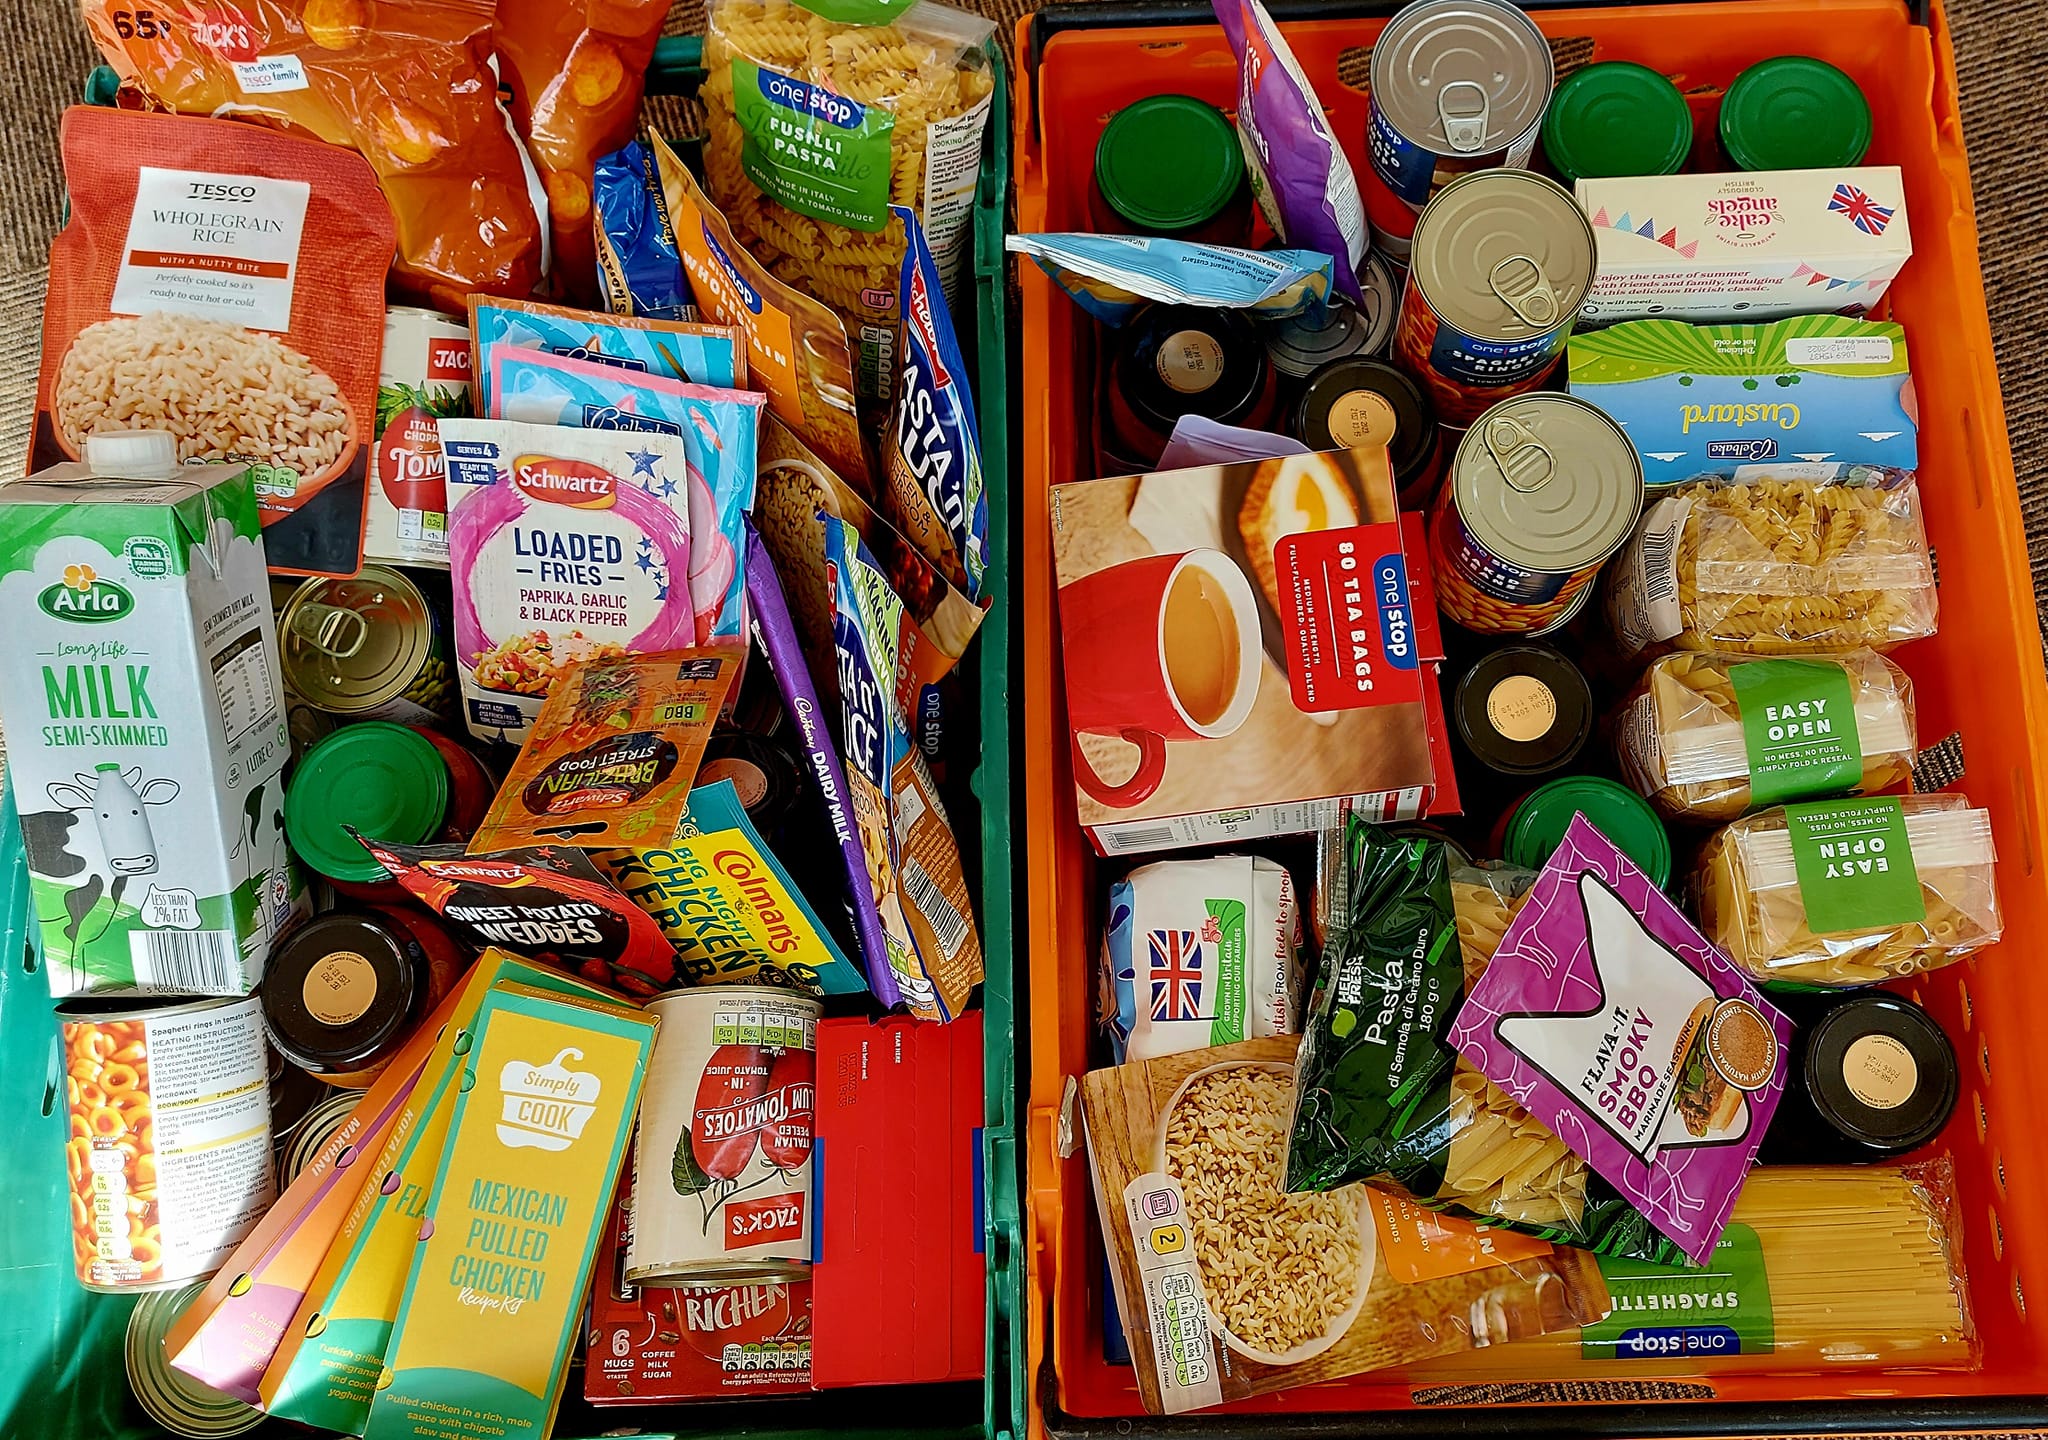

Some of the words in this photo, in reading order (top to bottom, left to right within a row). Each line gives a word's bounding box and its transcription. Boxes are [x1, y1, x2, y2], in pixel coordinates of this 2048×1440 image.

[192, 22, 250, 50] JACK'S
[272, 70, 300, 82] family
[770, 79, 804, 104] one
[808, 88, 852, 123] stop
[769, 116, 843, 155] FUSILLI
[775, 137, 837, 171] PASTA
[188, 183, 256, 201] TESCO
[751, 164, 778, 195] PERFECT
[809, 200, 846, 219] TOMATO
[849, 213, 875, 224] SAUCE
[775, 174, 798, 192] MADE
[811, 188, 835, 203] ITALY
[1717, 186, 1765, 195] GLORIOUSLY
[1707, 196, 1778, 214] angels
[153, 210, 284, 233] WHOLEGRAIN
[1719, 213, 1772, 232] cake
[192, 229, 236, 244] RICE
[159, 256, 186, 265] WITH
[199, 258, 233, 269] NUTTY
[236, 263, 261, 273] BITE
[1181, 255, 1209, 267] custard
[155, 273, 194, 285] Perfectly
[195, 277, 228, 288] cooked
[1618, 279, 1661, 288] friends
[1687, 278, 1725, 288] family,
[1726, 275, 1785, 287] indulging
[1629, 273, 1650, 281] the
[1652, 272, 1685, 280] taste
[1701, 270, 1751, 279] summer
[149, 288, 176, 300] ready
[235, 298, 255, 307] cold
[1628, 287, 1683, 296] delicious
[1684, 286, 1726, 295] British
[1680, 402, 1801, 435] Custard
[457, 446, 482, 455] SERVES
[1711, 438, 1776, 461] Belbake
[460, 470, 473, 482] 15
[519, 465, 611, 495] Schwartz
[513, 527, 622, 564] LOADED
[1338, 541, 1358, 571] 80
[541, 562, 602, 587] FRIES
[1382, 567, 1401, 605] one
[53, 584, 120, 613] Arla
[581, 592, 628, 609] GARLIC
[1302, 578, 1315, 615] MEDIUM
[1344, 576, 1365, 623] TEA
[520, 606, 529, 620] &
[532, 608, 576, 623] BLACK
[579, 611, 628, 627] PEPPER
[1308, 617, 1321, 665] STRENGTH
[1387, 608, 1409, 657] stop
[57, 640, 98, 661] Long
[100, 640, 129, 660] Life
[1299, 629, 1312, 669] QUALITY
[1350, 629, 1375, 693] BAGS
[42, 665, 158, 719] MILK
[1305, 672, 1316, 703] BLEND
[664, 705, 694, 720] BBQ
[926, 692, 941, 719] one
[1766, 699, 1828, 723] EASY
[42, 725, 169, 747] SEMI-SKIMMED
[793, 697, 816, 750] Cadbury
[1767, 718, 1832, 742] OPEN
[925, 723, 940, 755] stop
[558, 755, 598, 772] FOOD
[598, 746, 657, 767] STREET
[1757, 762, 1788, 774] SIMPLY
[1789, 759, 1811, 770] FOLD
[1820, 753, 1853, 766] RESEAL
[1763, 752, 1776, 763] NO
[1777, 749, 1803, 762] MESS,
[1805, 747, 1817, 758] NO
[1818, 745, 1843, 756] FUSS,
[553, 791, 628, 810] Schwartz
[811, 751, 840, 803] DAIRY
[828, 803, 853, 846] MILK
[1866, 805, 1895, 816] SIMPLY
[1796, 814, 1829, 824] RESEAL
[1838, 808, 1863, 818] FOLD
[1819, 837, 1886, 859] OPEN
[428, 864, 526, 880] Schwartz
[1825, 858, 1889, 880] EASY
[151, 892, 167, 906] LESS
[167, 893, 188, 906] THAN
[673, 846, 710, 880] BIG
[701, 885, 757, 944] NIGHT
[712, 849, 800, 955] Colman's
[153, 906, 172, 924] 2%
[173, 907, 190, 923] FAT
[445, 904, 515, 922] SWEET
[517, 903, 602, 920] POTATO
[640, 848, 761, 975] CHICKEN
[471, 918, 604, 945] WEDGES
[1234, 927, 1242, 963] FARMERS
[1412, 927, 1429, 961] Duro
[1221, 938, 1234, 981] Britain
[1275, 961, 1286, 995] FROM
[1337, 956, 1358, 1005] HELLO
[1348, 955, 1365, 1006] FRESH
[1405, 961, 1423, 1005] Grano
[1223, 997, 1232, 1023] GROWN
[1232, 983, 1242, 1034] SUPPORTING
[1364, 958, 1405, 1046] Pasta
[151, 1023, 192, 1037] Spaghetti
[1419, 1004, 1435, 1033] 180
[1711, 1005, 1743, 1051] INGREDIENTS
[151, 1035, 192, 1048] HEATING
[193, 1023, 246, 1041] INSTRUCTIONS
[1390, 1022, 1413, 1073] Semola
[706, 1066, 733, 1077] JUICE
[734, 1065, 769, 1077] TOMATO
[1597, 1005, 1655, 1114] SMOKY
[1717, 1053, 1750, 1082] NATURAL
[522, 1069, 582, 1097] Simply
[1633, 1074, 1669, 1142] MARINADE
[1663, 1018, 1696, 1083] SEASONING
[1615, 1064, 1660, 1132] BBQ
[517, 1100, 573, 1133] COOK
[704, 1086, 790, 1139] TOMATOES
[387, 1107, 415, 1154] KOFTA
[774, 1136, 811, 1150] ITALIAN
[778, 1125, 811, 1138] PEELED
[311, 1116, 362, 1178] MAKHANI
[343, 1149, 398, 1240] FLATBREADS
[467, 1178, 569, 1227] MEXICAN
[733, 1204, 801, 1236] JACK'S
[1383, 1198, 1401, 1244] SECONDS
[466, 1218, 549, 1263] PULLED
[449, 1254, 547, 1303] CHICKEN
[456, 1284, 503, 1315] Recipe
[685, 1284, 788, 1332] RICHER
[1612, 1292, 1739, 1312] SPAGHETTI
[319, 1342, 354, 1359] Turkish
[611, 1328, 632, 1358] 6
[641, 1350, 676, 1359] COFFEE
[1630, 1331, 1682, 1355] stop
[1686, 1332, 1727, 1350] one
[604, 1359, 635, 1369] MUGS
[641, 1371, 673, 1380] SUGAR
[647, 1361, 669, 1369] MILK
[385, 1393, 420, 1408] Pulled
[420, 1399, 461, 1417] chicken
[439, 1412, 463, 1428] with
[463, 1418, 506, 1438] chipotle
